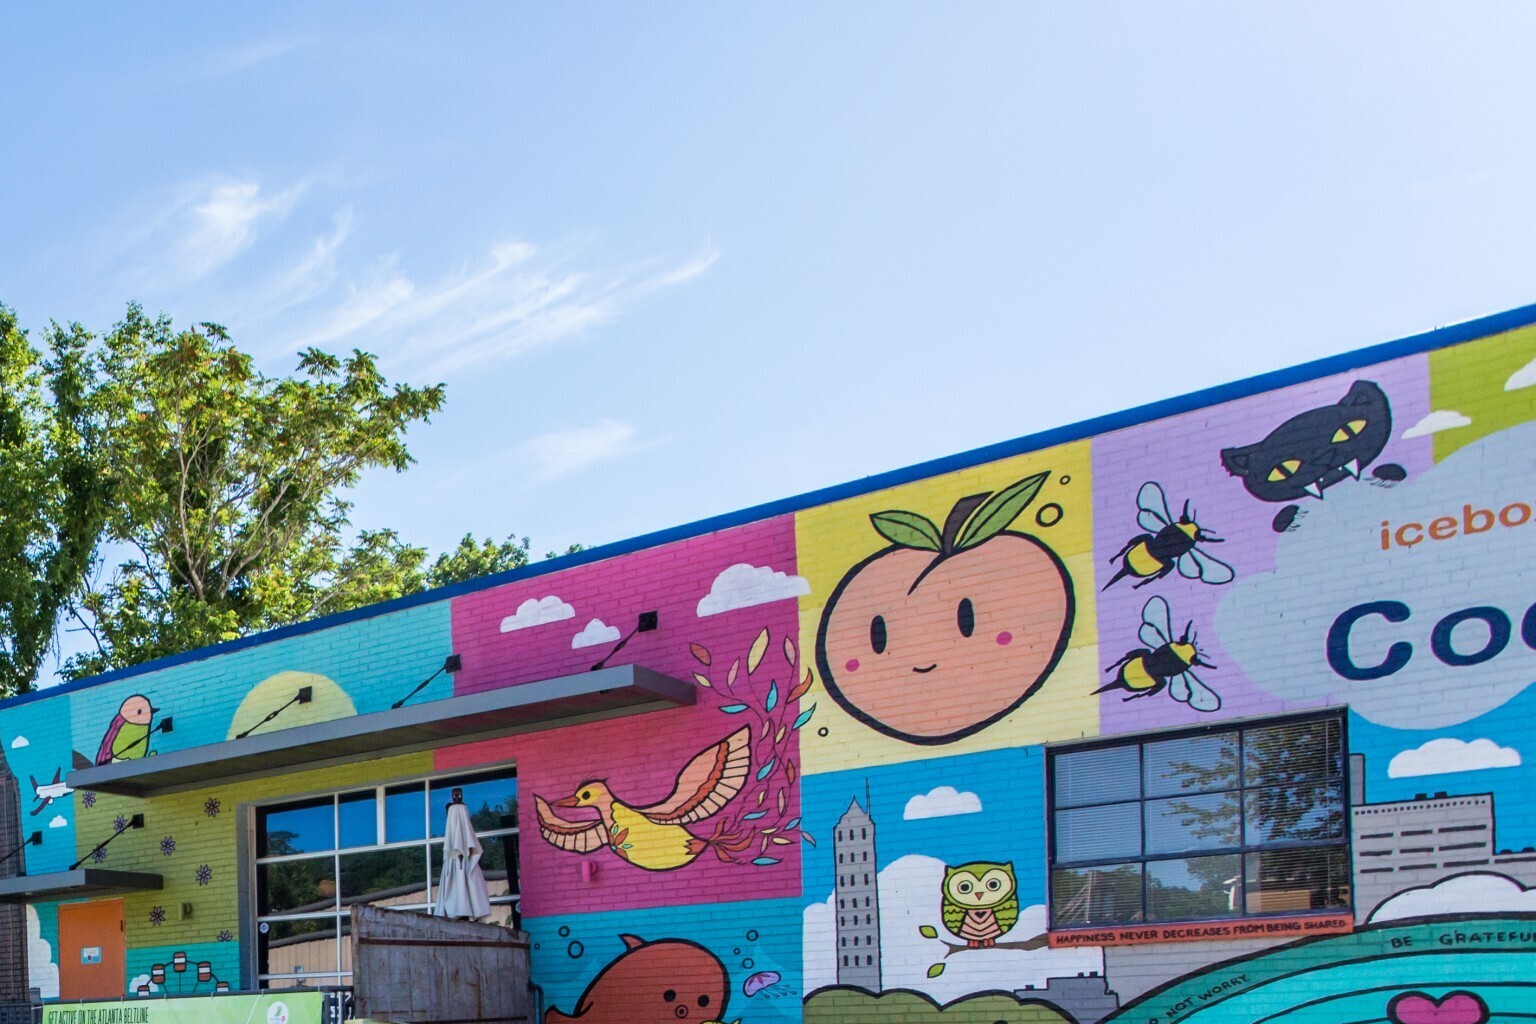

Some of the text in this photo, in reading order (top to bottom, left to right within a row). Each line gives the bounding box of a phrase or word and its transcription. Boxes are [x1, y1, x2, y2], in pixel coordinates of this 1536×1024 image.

[1381, 503, 1536, 550] icebo
[1326, 600, 1536, 681] Co
[1056, 919, 1346, 945] HAPPINESS NEVER DECREASES FROM BEING SHARED
[1390, 935, 1413, 949] BE
[78, 1010, 85, 1024] ON
[87, 1009, 97, 1024] THE
[98, 1008, 123, 1024] ATLANTA
[124, 1007, 149, 1024] BELTLINE
[1166, 997, 1194, 1018] NOT
